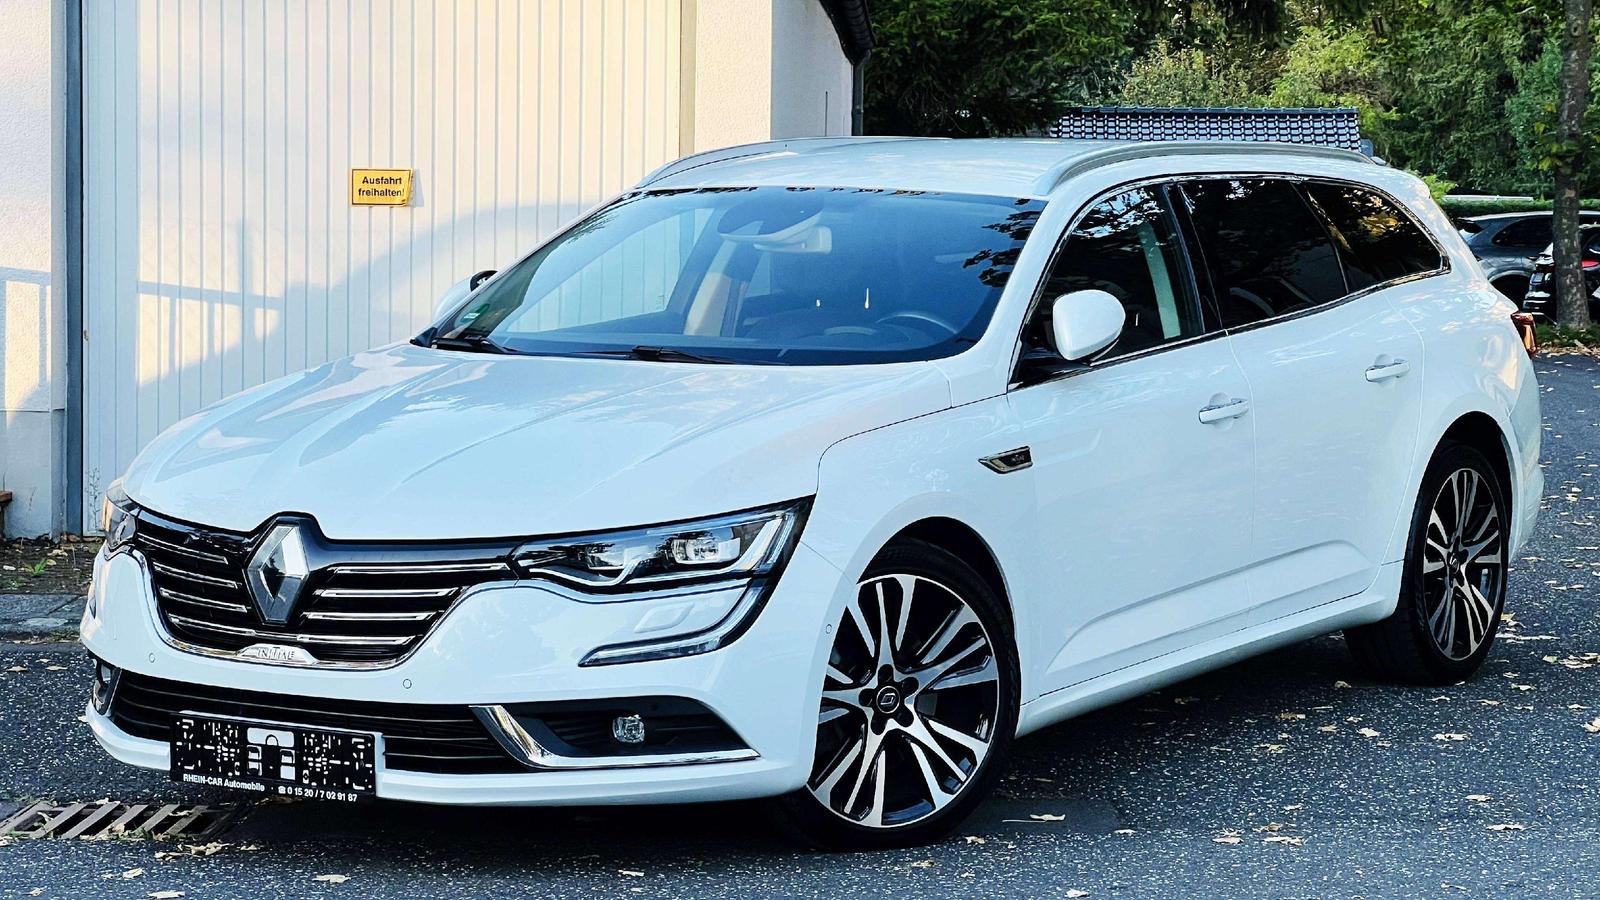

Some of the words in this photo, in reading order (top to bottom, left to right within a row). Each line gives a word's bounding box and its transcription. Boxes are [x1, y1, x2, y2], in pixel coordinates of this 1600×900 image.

[362, 176, 402, 184] Ausfahrt
[358, 188, 405, 196] freihalten!
[183, 773, 223, 786] RHEIN-CAR
[224, 779, 265, 791] Automobile
[294, 787, 303, 796] 15
[304, 788, 314, 797] 20
[326, 791, 336, 800] 02
[337, 792, 346, 801] 91
[347, 793, 358, 802] 87
